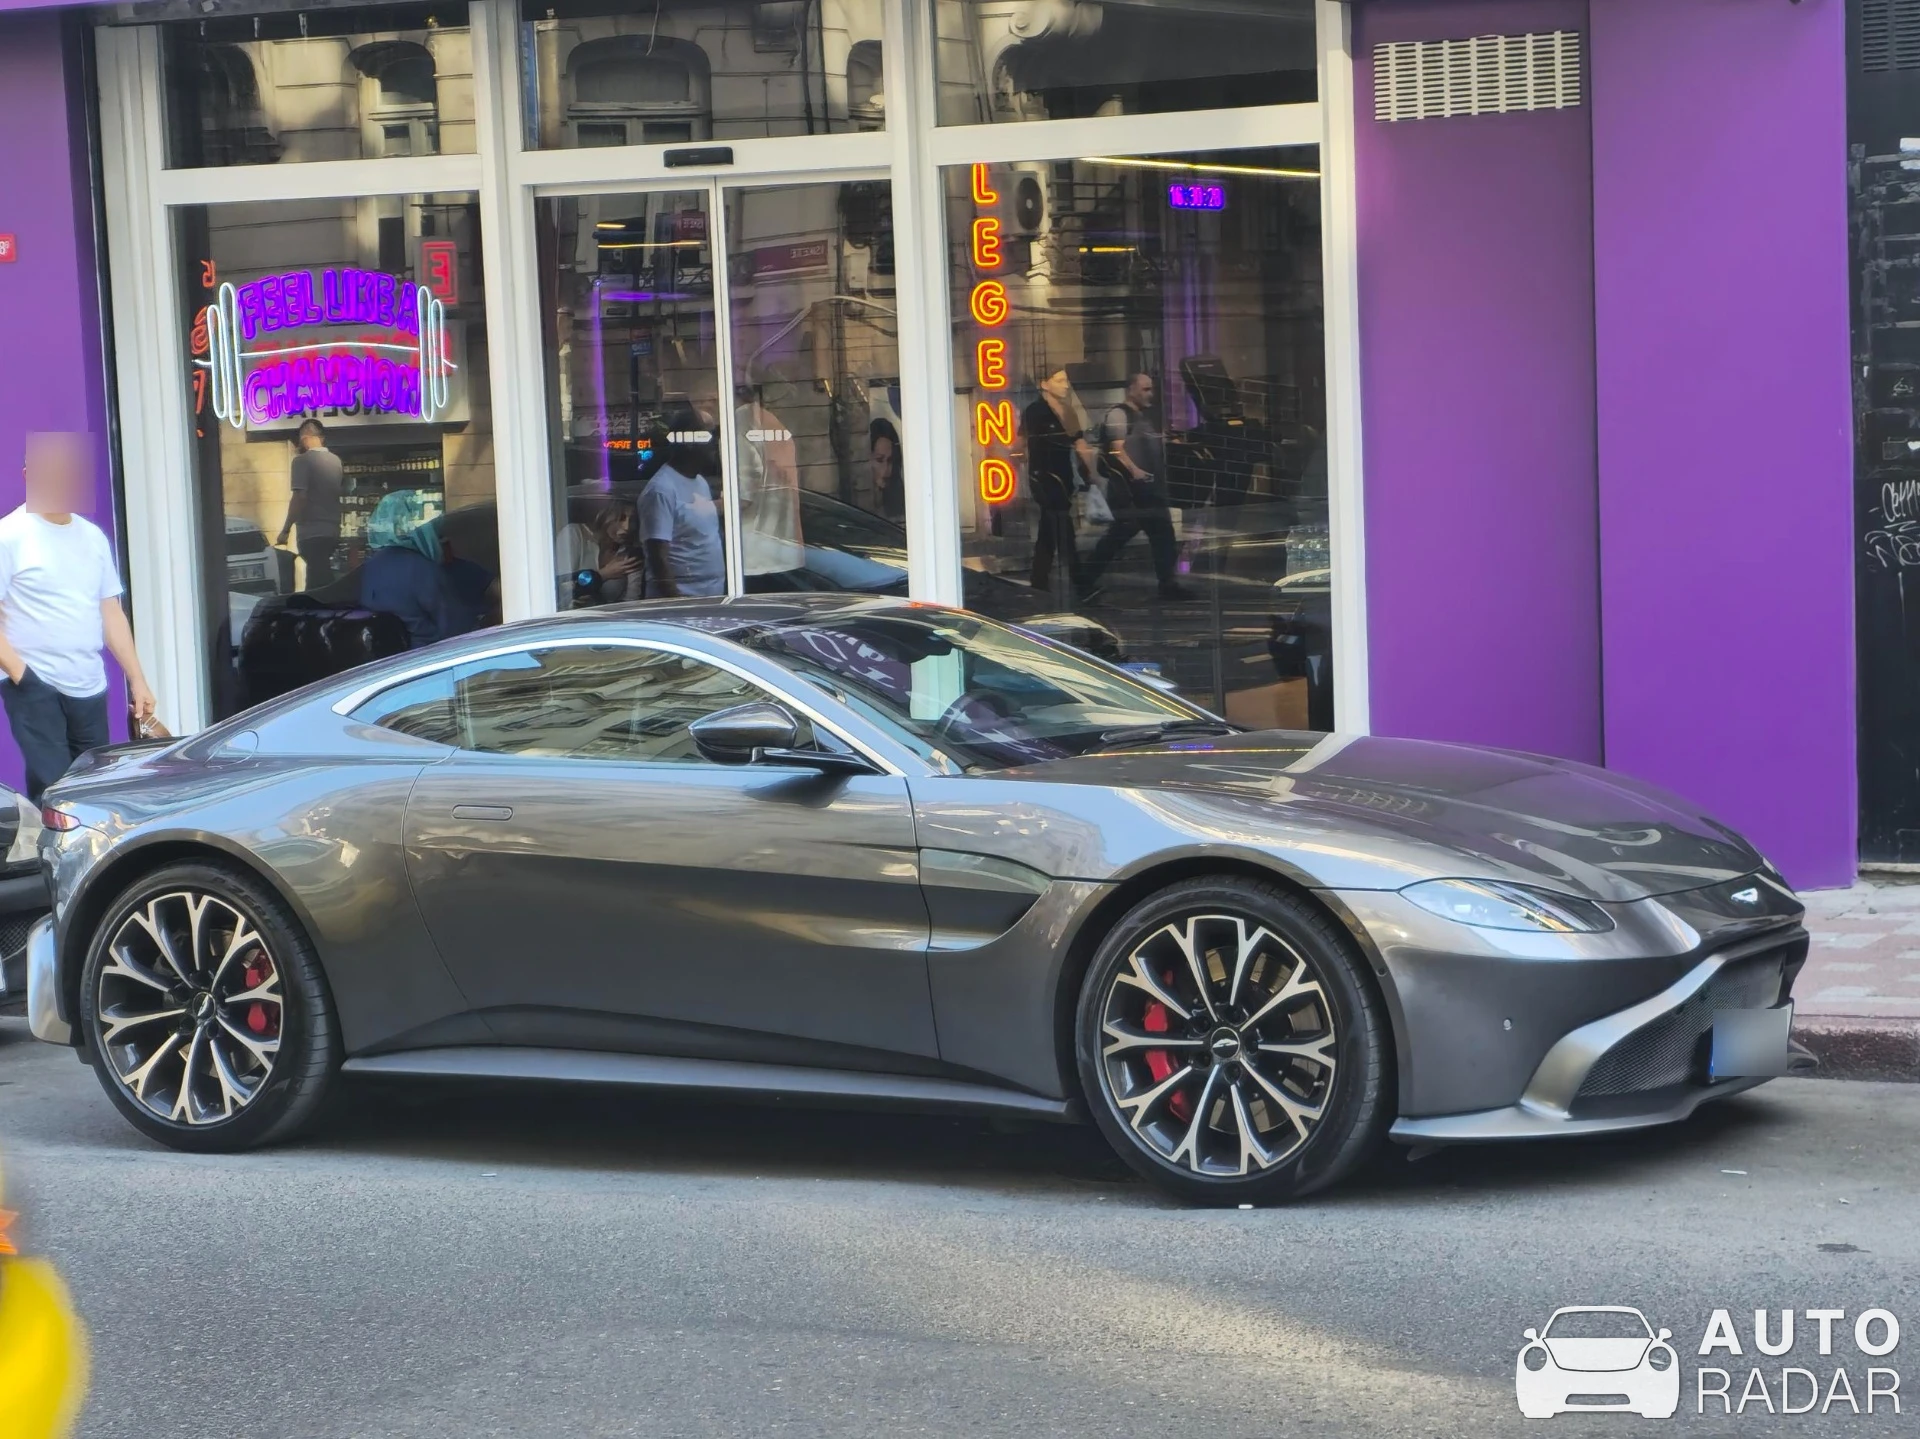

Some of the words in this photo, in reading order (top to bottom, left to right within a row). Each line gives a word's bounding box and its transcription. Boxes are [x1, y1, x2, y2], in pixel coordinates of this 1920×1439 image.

[237, 269, 323, 340] FEEL
[323, 268, 396, 327] LIKE
[396, 282, 419, 336] A
[971, 162, 1014, 502] LEGEND
[243, 355, 422, 425] CHAMPION
